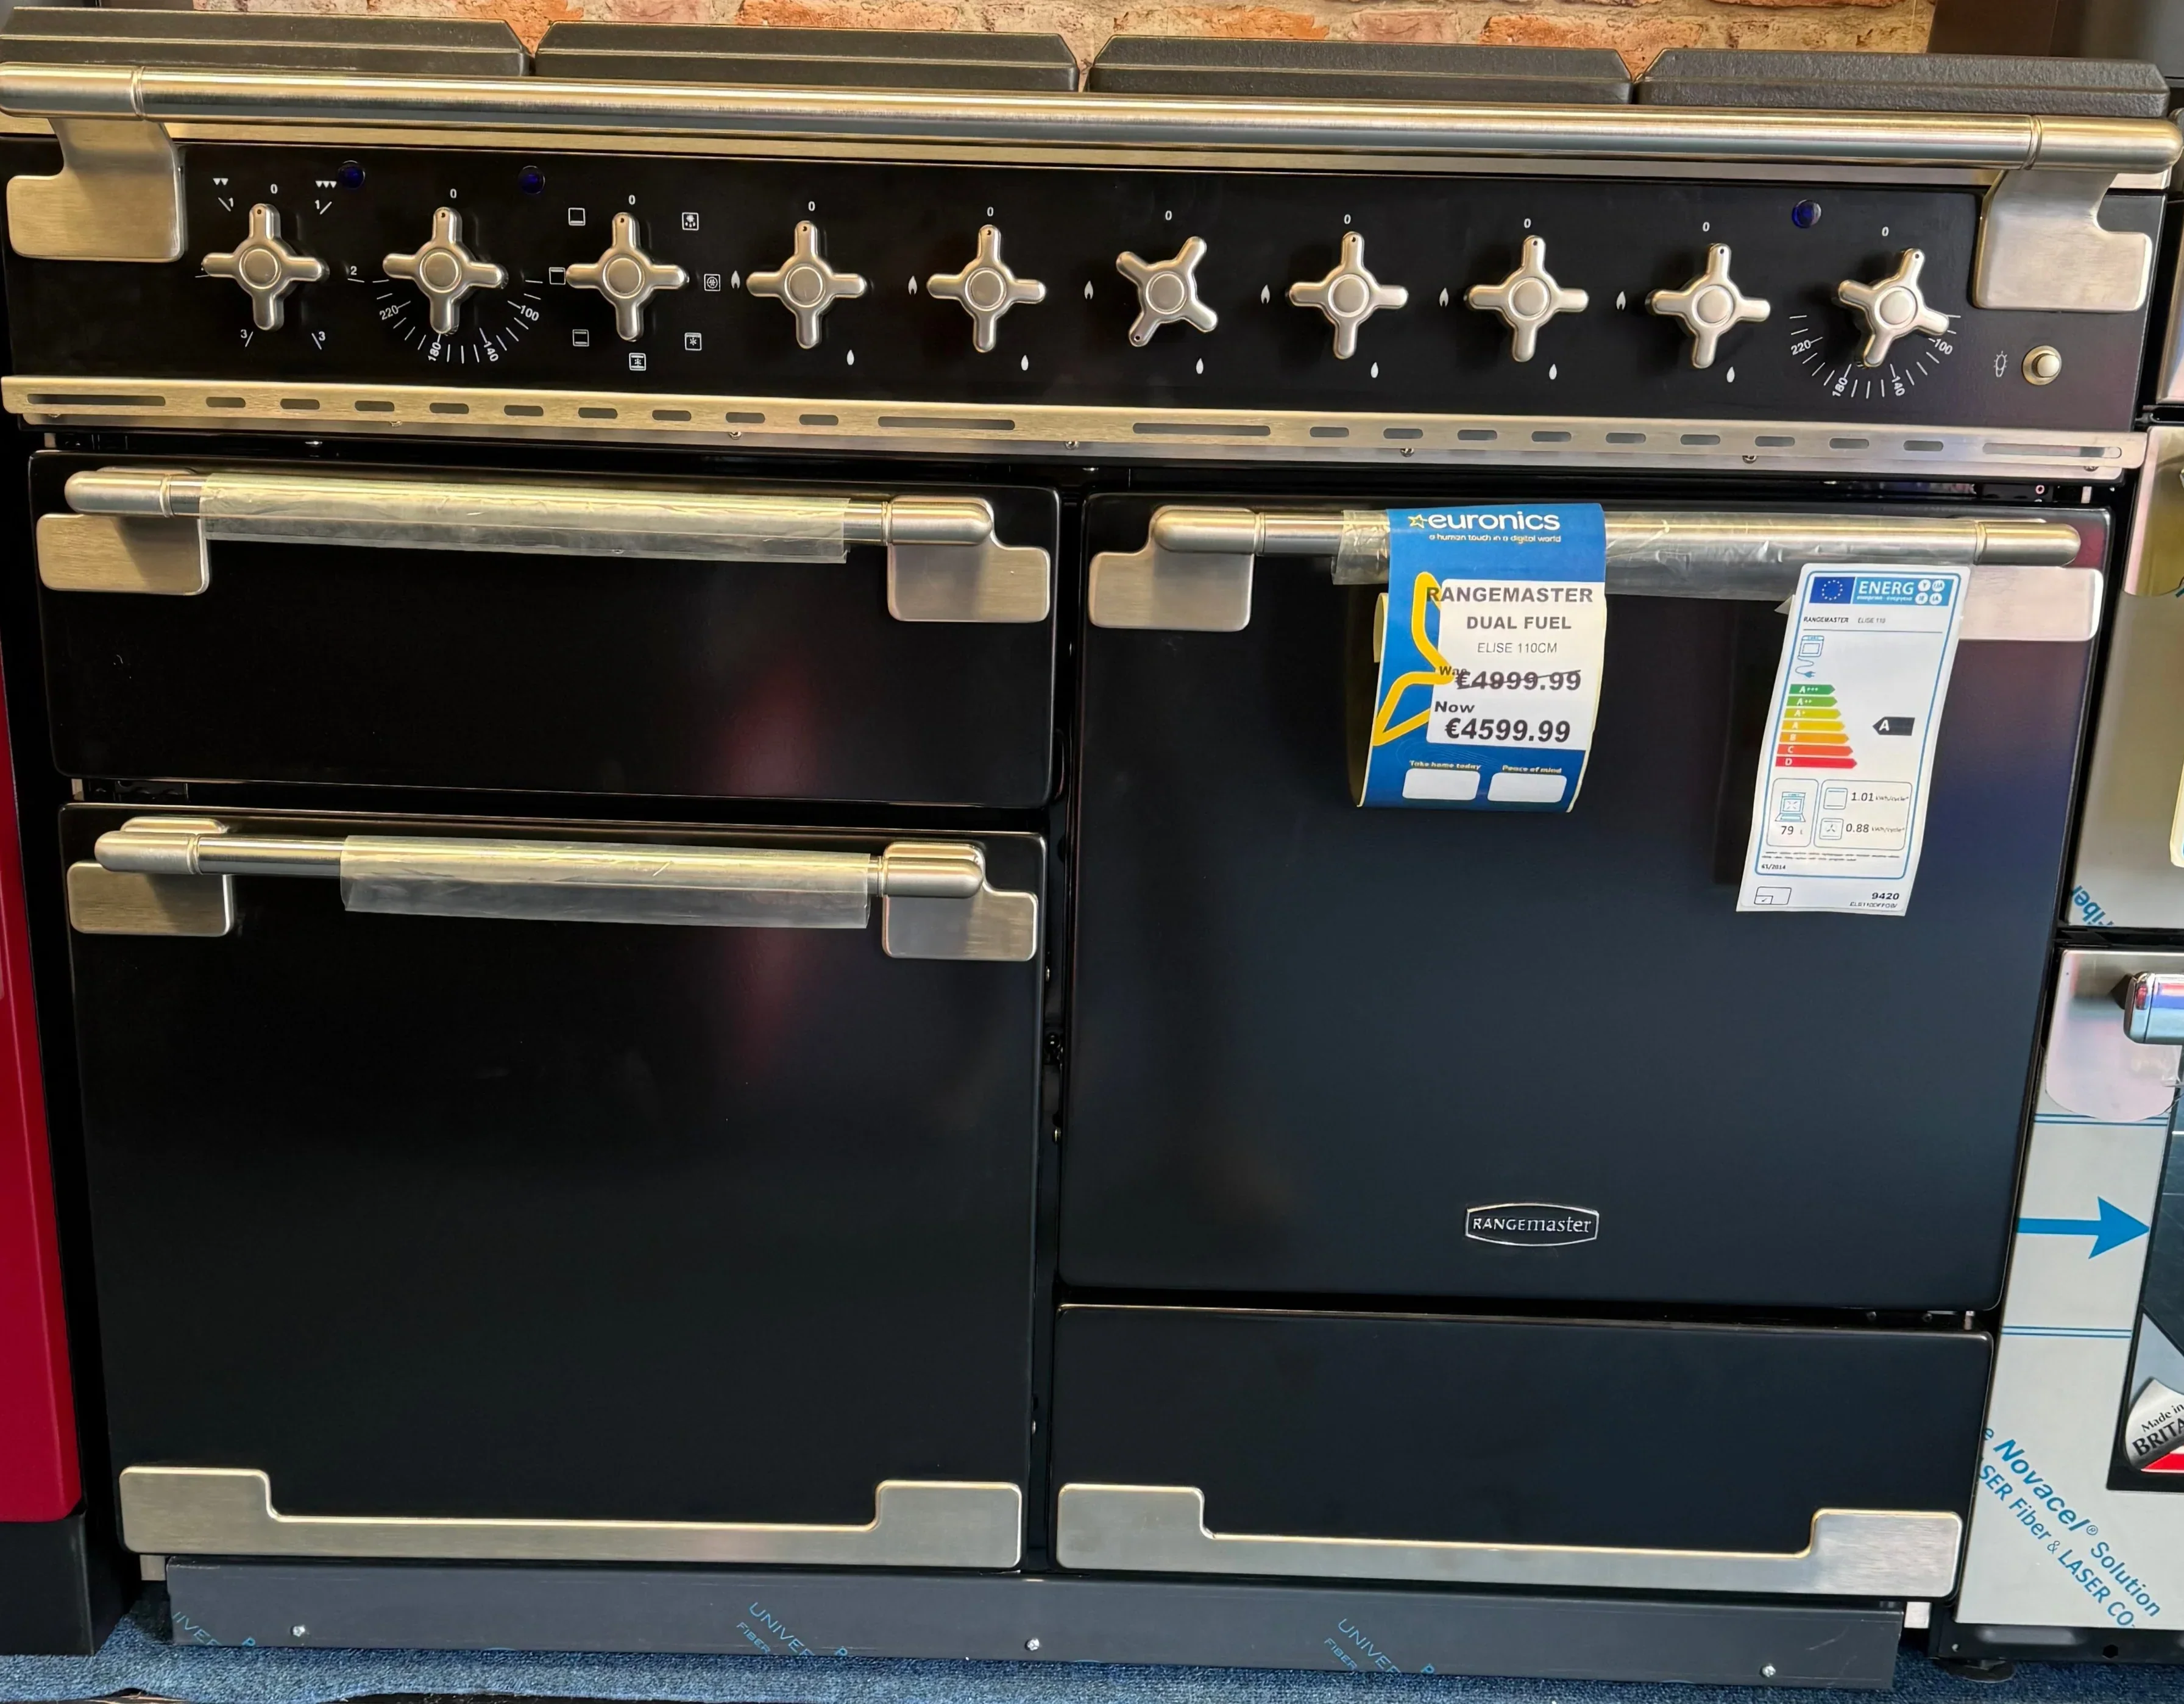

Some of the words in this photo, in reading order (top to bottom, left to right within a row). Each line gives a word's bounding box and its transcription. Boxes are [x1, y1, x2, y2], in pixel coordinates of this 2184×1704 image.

[350, 266, 357, 275] 2
[378, 305, 400, 321] 220
[520, 305, 539, 322] 100
[240, 329, 247, 339] 3
[319, 331, 326, 341] 3
[428, 341, 442, 363] 180
[484, 341, 500, 363] 140
[1790, 339, 1812, 356] 220
[1934, 339, 1953, 355] 100
[1832, 377, 1848, 398] 180
[1891, 376, 1906, 397] 140
[1428, 511, 1560, 531] euronics
[1511, 534, 1536, 544] digital
[1426, 587, 1593, 603] RANGEMASTER
[1859, 581, 1915, 595] ENERG
[1467, 616, 1517, 630] DUAL
[1524, 616, 1572, 630] FUEL
[1477, 642, 1512, 653] ELISE
[1518, 643, 1558, 654] 110CM
[1455, 670, 1581, 690] €4999.99
[1434, 701, 1475, 713] Now
[1445, 717, 1570, 742] €4599.99
[1792, 722, 1798, 730] A
[1879, 719, 1890, 731] A
[1789, 733, 1796, 742] B
[1787, 745, 1794, 753] C
[1784, 758, 1792, 767] D
[1851, 792, 1874, 801] 1.01
[1781, 825, 1794, 835] 79
[1846, 823, 1870, 833] 0.88
[1871, 892, 1901, 901] 9420
[1473, 1216, 1592, 1232] RANGEmaster
[2141, 1412, 2172, 1432] Made
[2171, 1404, 2184, 1414] in
[1979, 1465, 2013, 1501] SER
[2008, 1497, 2052, 1540] Fiber
[2047, 1540, 2060, 1555] &
[2058, 1549, 2111, 1604] LASER
[2107, 1601, 2135, 1628] CO
[2091, 1541, 2161, 1617] Solution
